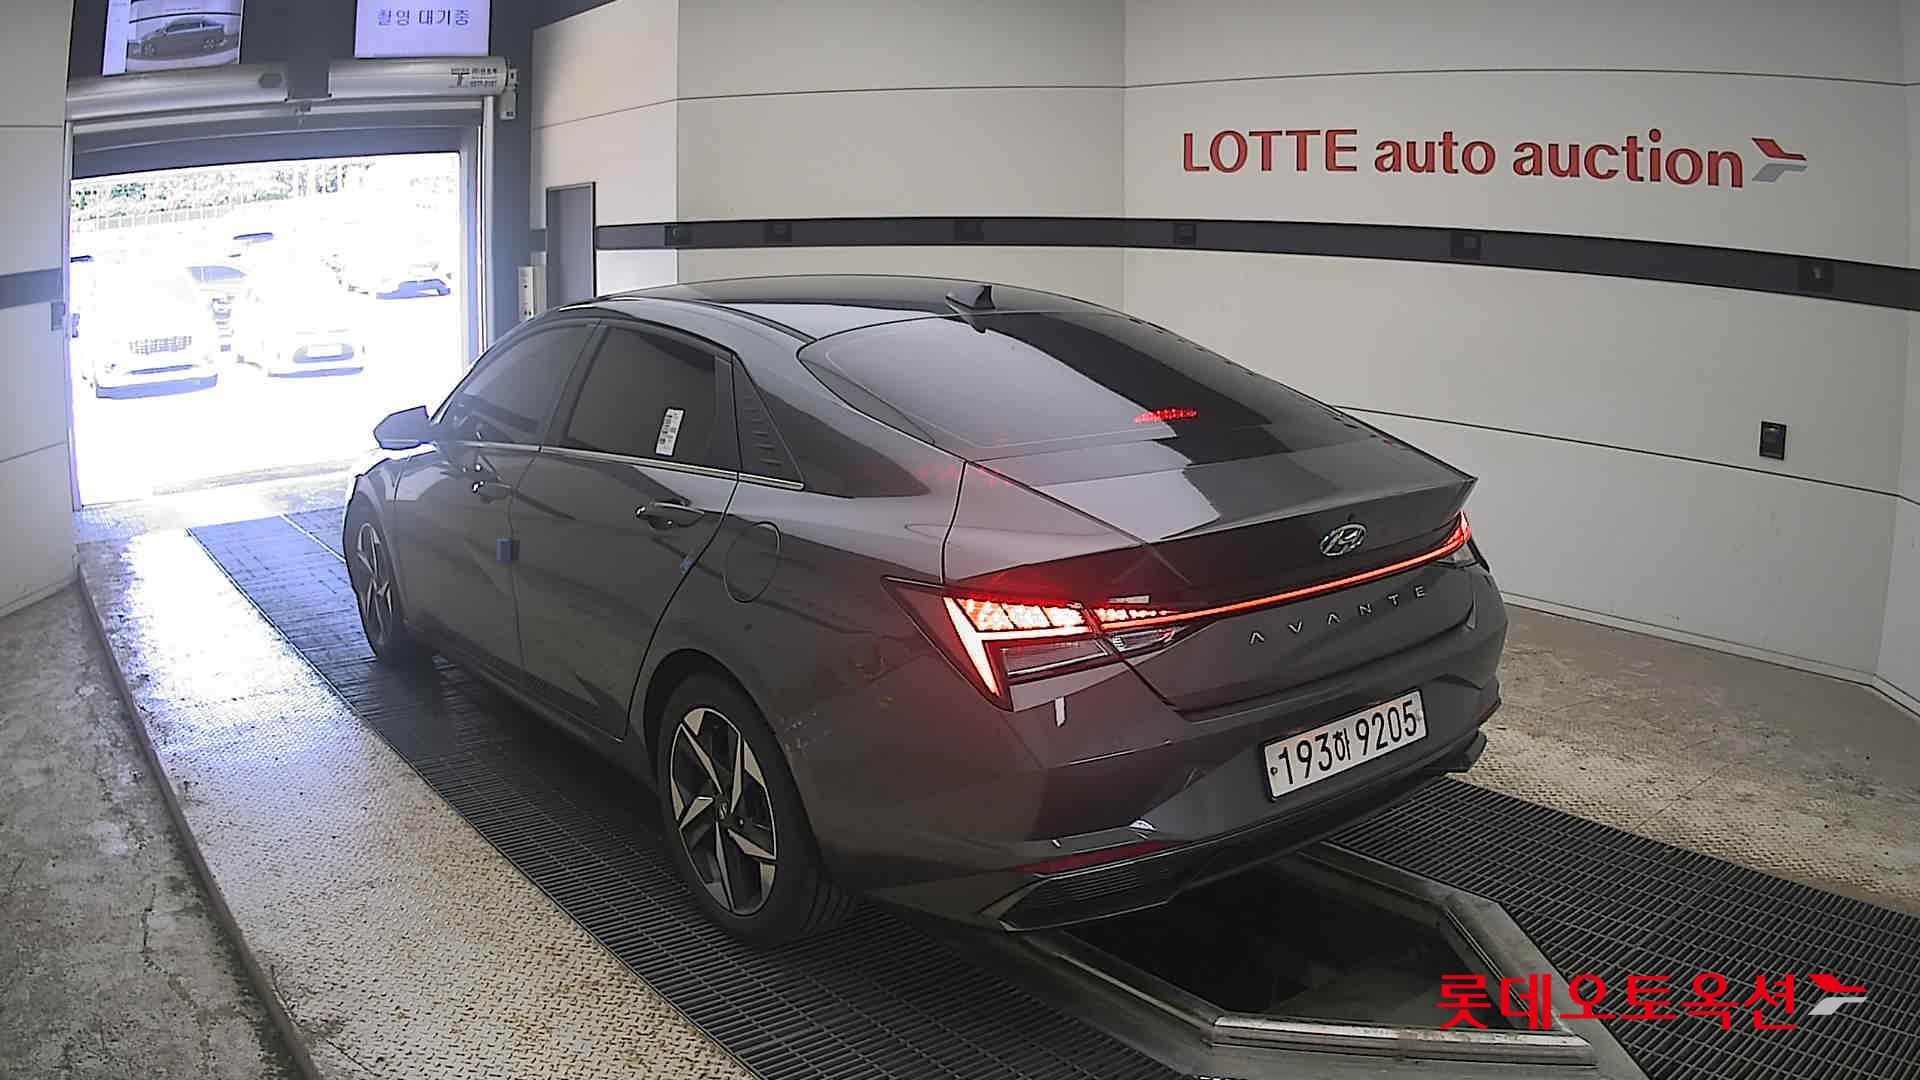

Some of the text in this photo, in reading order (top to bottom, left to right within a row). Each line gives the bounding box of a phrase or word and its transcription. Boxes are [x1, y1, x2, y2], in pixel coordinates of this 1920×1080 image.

[418, 9, 469, 26] 대기중
[1184, 129, 1744, 187] LOTTE auto auction
[1249, 586, 1426, 645] AVANTE
